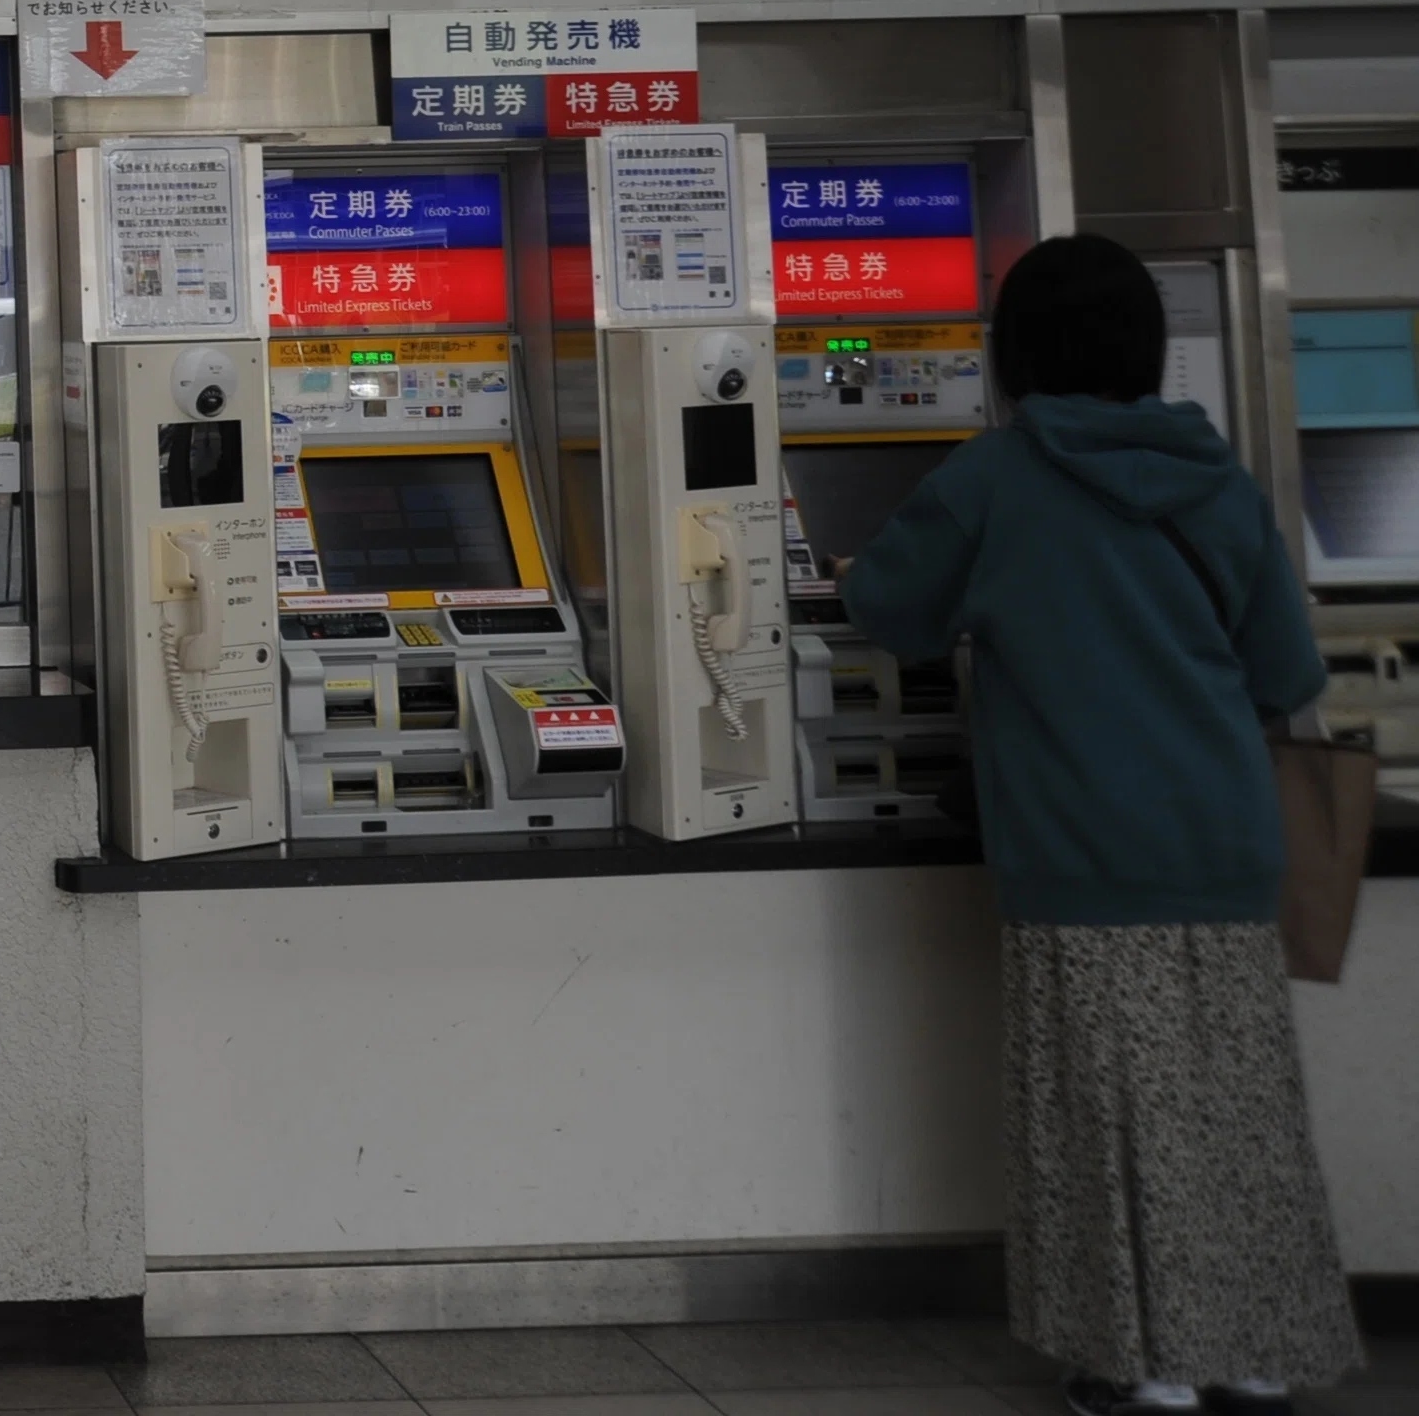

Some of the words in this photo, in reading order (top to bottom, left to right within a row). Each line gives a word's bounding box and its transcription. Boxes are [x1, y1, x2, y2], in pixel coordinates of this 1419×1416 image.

[27, 0, 177, 16] でお知らせください。
[445, 18, 642, 53] 自動発売機
[492, 56, 542, 68] Vending
[546, 54, 597, 66] Machine
[412, 85, 528, 117] 定期券
[565, 80, 681, 113] 特急券
[437, 121, 464, 132] Train
[466, 121, 503, 131] Passes
[565, 118, 601, 130] Limited
[781, 179, 884, 209] 定期券
[309, 189, 414, 220] 定期券
[781, 214, 844, 227] Commuter
[846, 213, 884, 226] Passes
[309, 225, 373, 239] Commuter
[375, 224, 414, 237] Passes
[785, 252, 888, 282] 特急券
[311, 263, 417, 294] 特急券
[818, 288, 861, 304] Express
[863, 286, 904, 300] Tickets
[297, 300, 343, 314] Limited
[345, 299, 390, 317] Express
[392, 298, 432, 312] Tickets
[825, 338, 869, 351] 発売中
[349, 351, 395, 365] 発売中
[215, 517, 266, 531] インターホン
